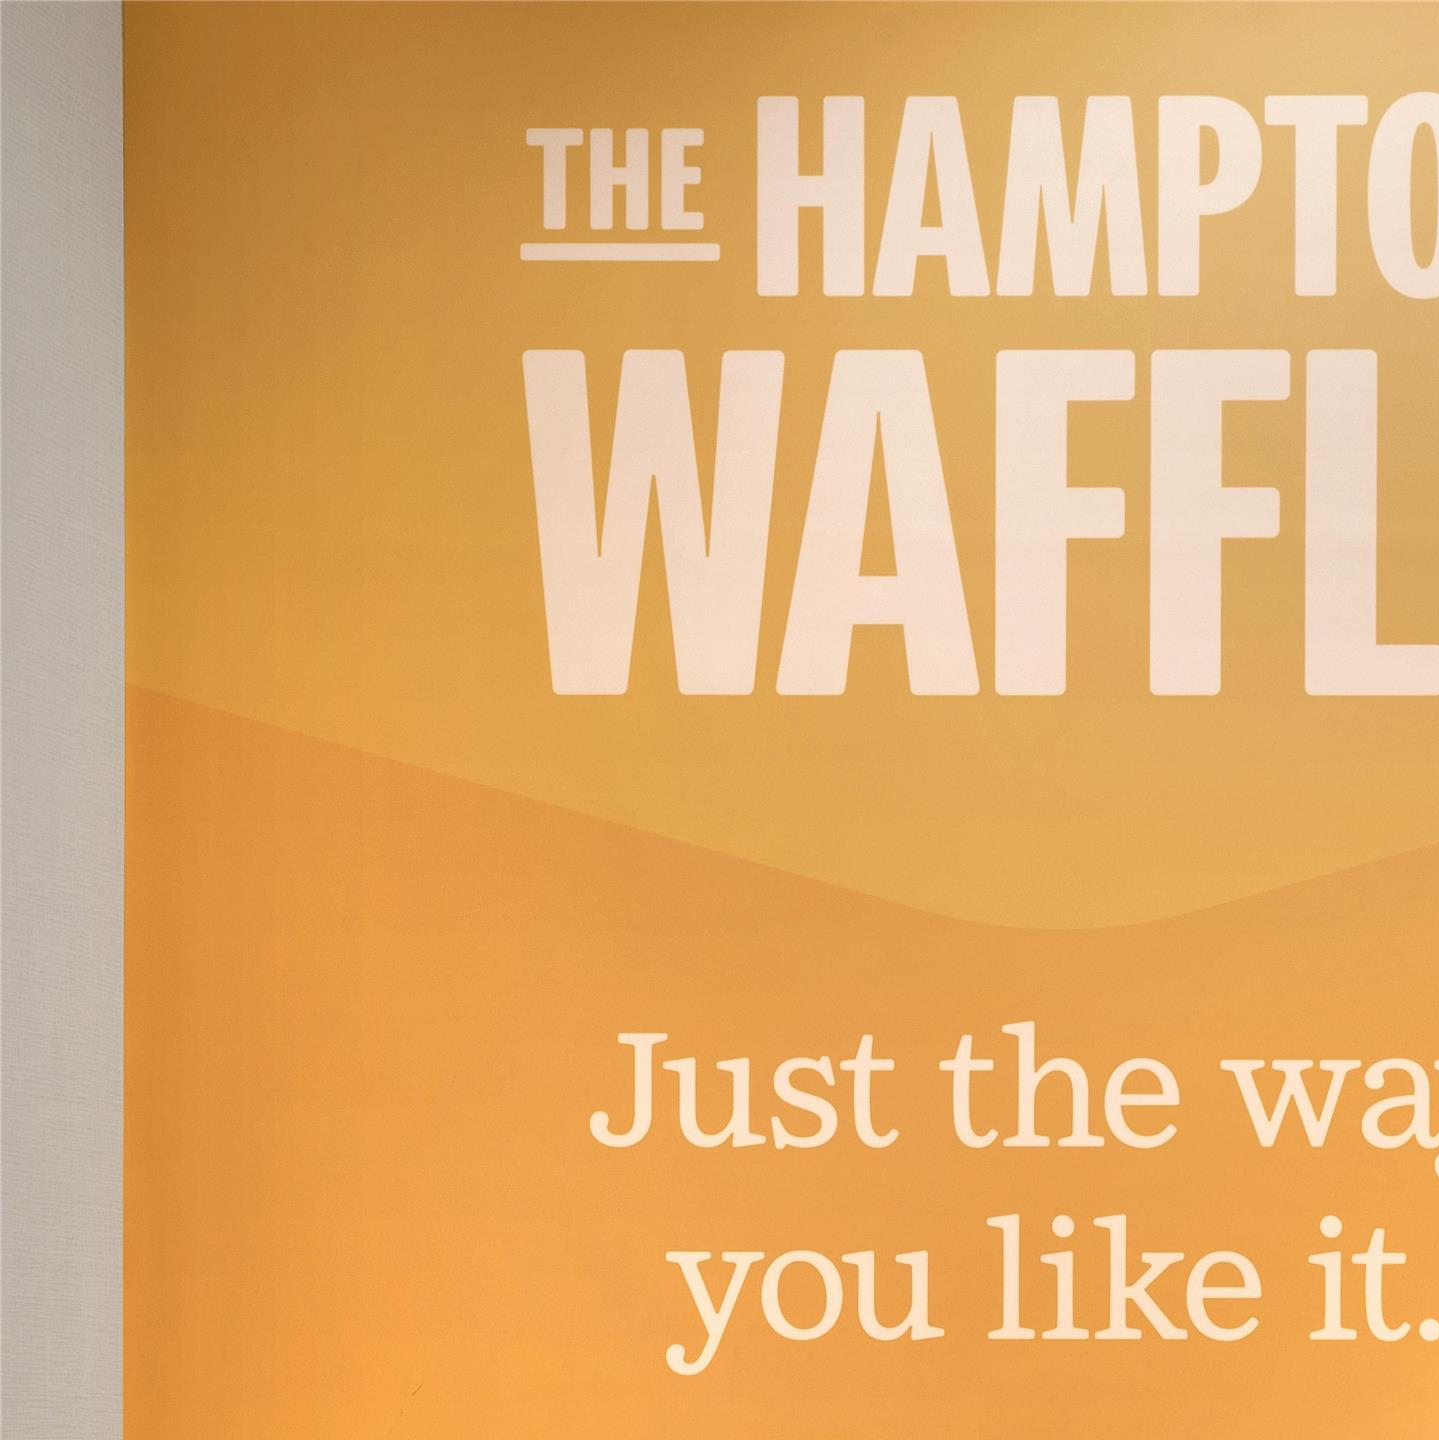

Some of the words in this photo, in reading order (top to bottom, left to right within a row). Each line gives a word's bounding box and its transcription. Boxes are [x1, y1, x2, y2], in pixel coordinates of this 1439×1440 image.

[526, 128, 704, 229] THE
[590, 1032, 899, 1149] Just
[940, 1021, 1180, 1148] the
[665, 1250, 944, 1375] you
[987, 1213, 1261, 1341] like
